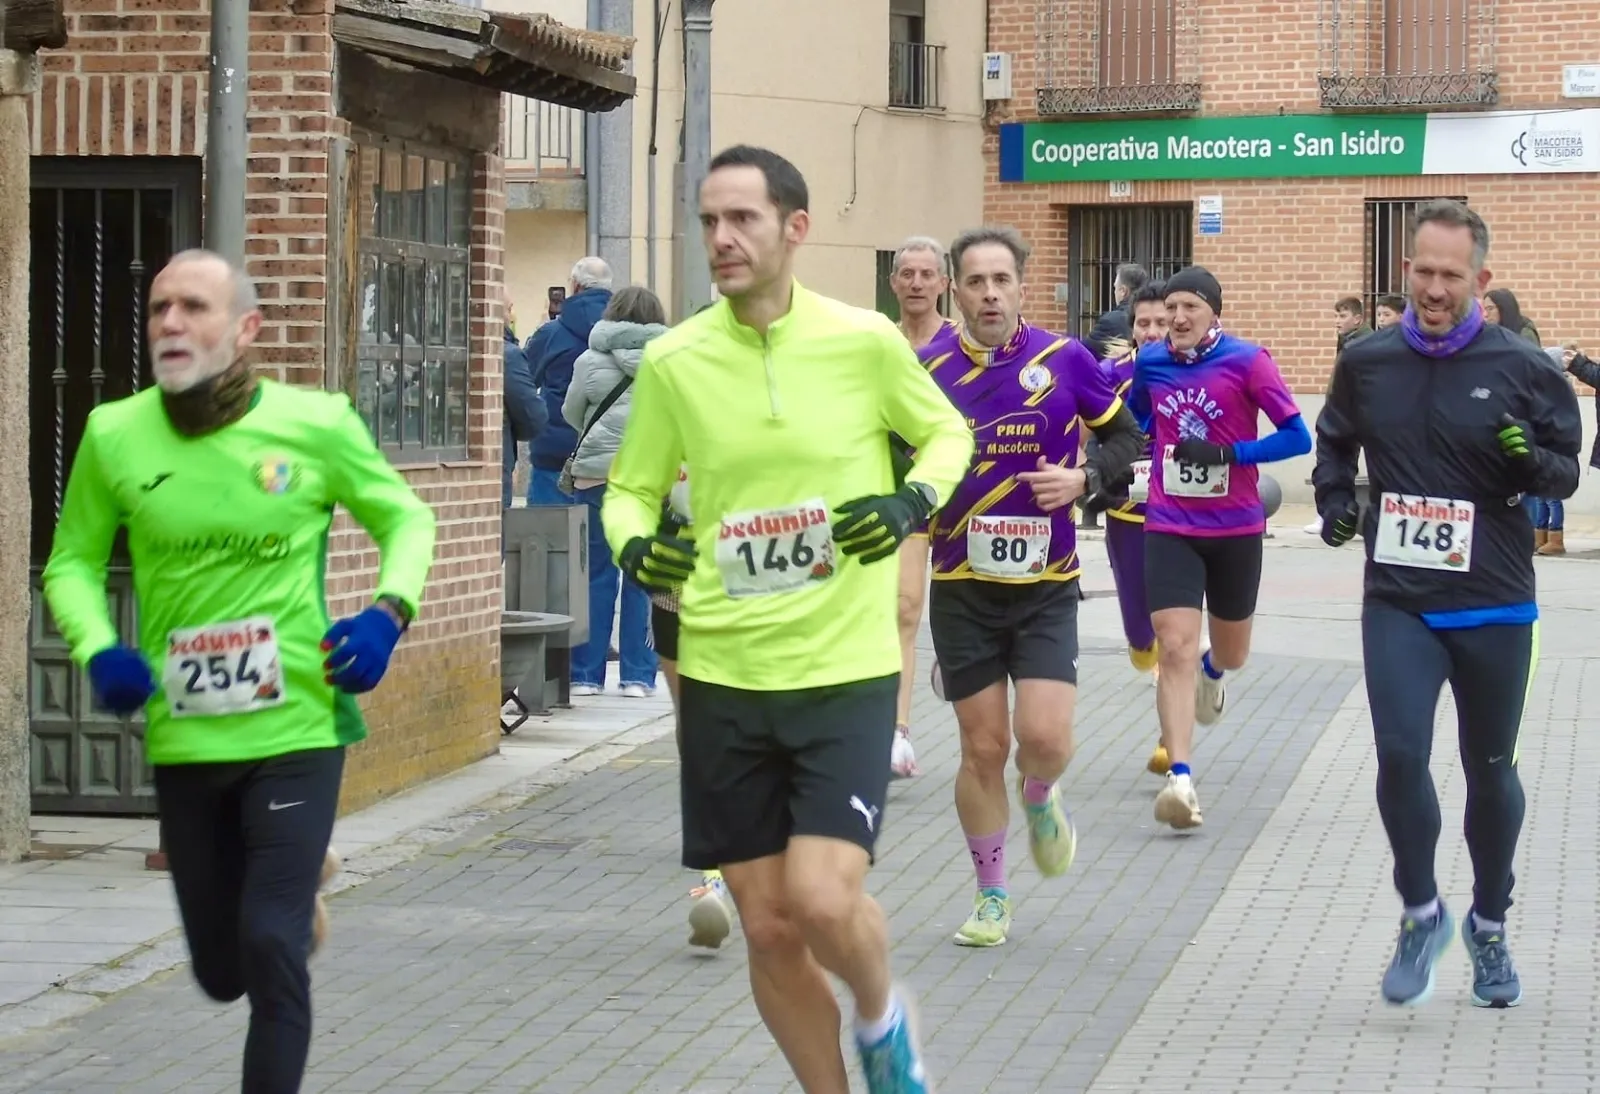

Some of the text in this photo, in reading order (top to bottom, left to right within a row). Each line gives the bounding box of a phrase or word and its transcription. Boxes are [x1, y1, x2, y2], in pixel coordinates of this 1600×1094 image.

[1031, 136, 1159, 168] Cooperativa
[1167, 134, 1272, 160] Macotera
[1293, 132, 1334, 157] San
[1341, 129, 1405, 156] Isidro
[1534, 137, 1583, 147] MACOTERA
[1534, 148, 1584, 158] SAN ISIDRO
[1114, 181, 1127, 193] 10
[1157, 387, 1224, 420] Apaches
[996, 424, 1036, 437] PRIM
[986, 441, 1040, 455] Macotera
[1180, 462, 1209, 484] 53
[719, 507, 826, 540] bedunia
[970, 519, 1050, 536] bedunia
[1396, 518, 1453, 552] 148
[736, 532, 815, 576] 146
[991, 537, 1028, 563] 80
[180, 649, 261, 695] 254
